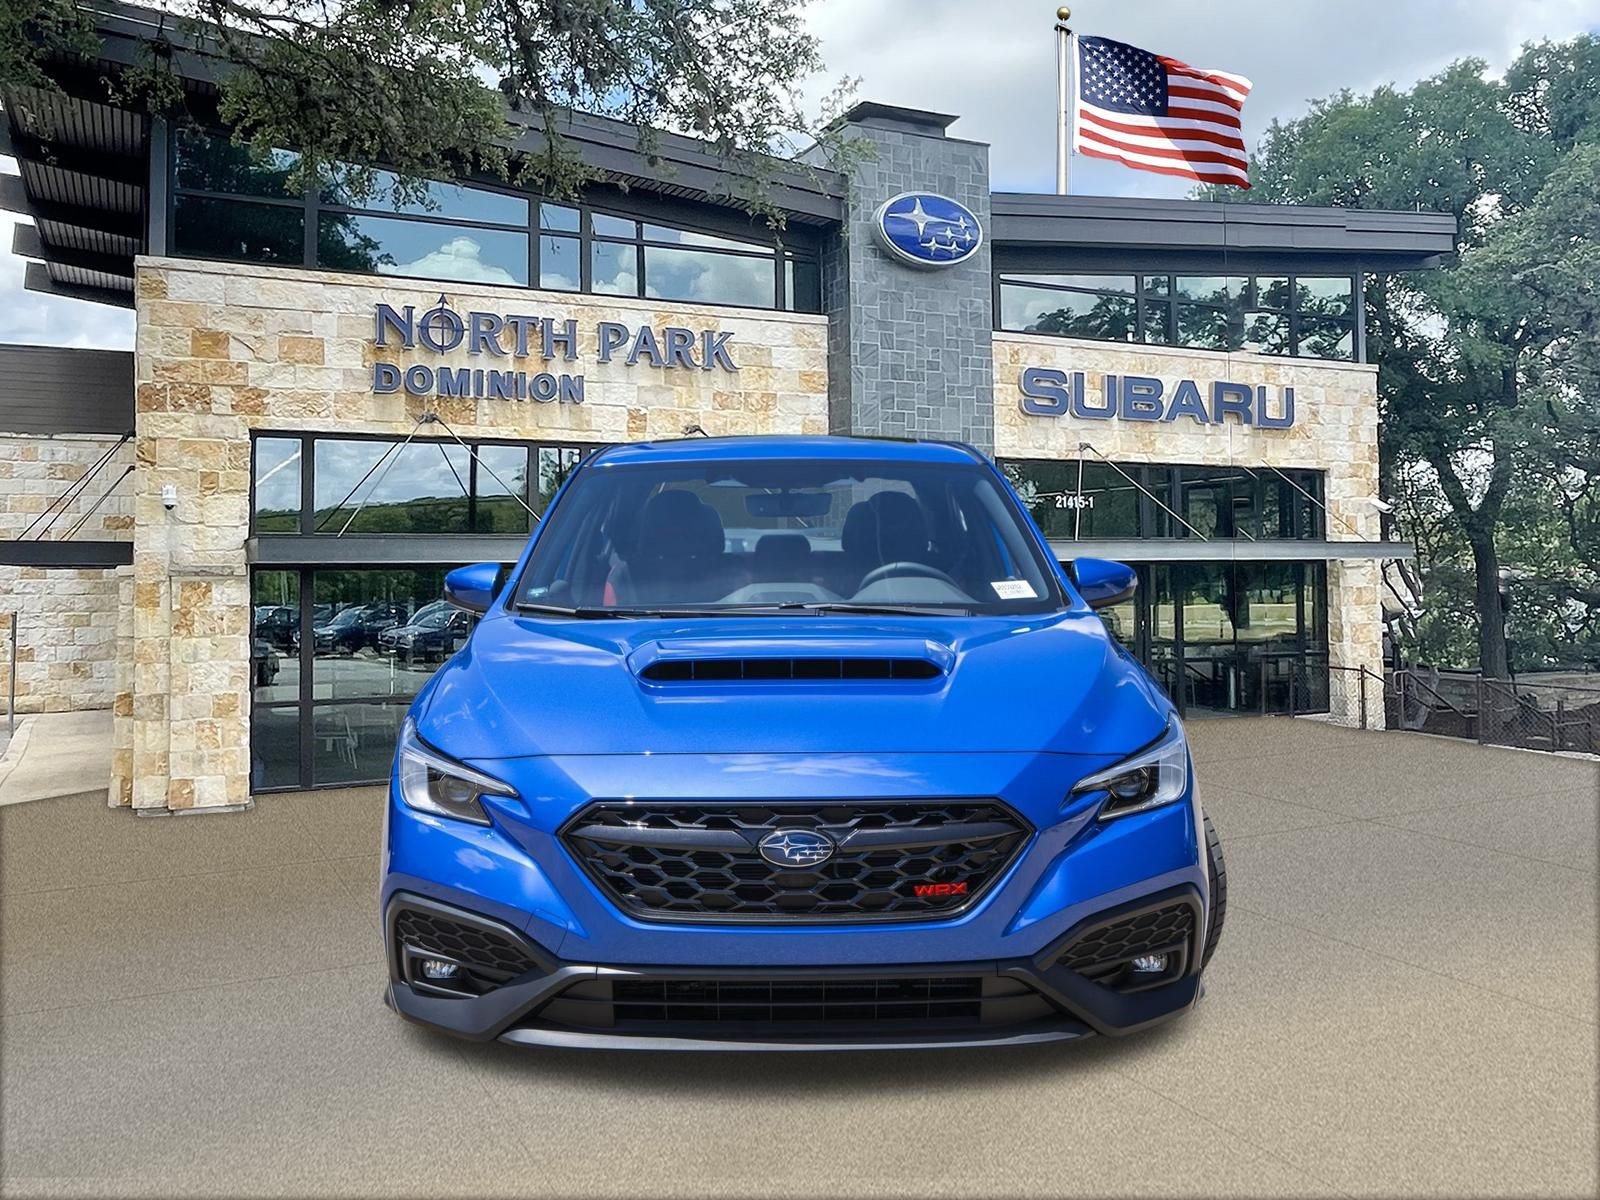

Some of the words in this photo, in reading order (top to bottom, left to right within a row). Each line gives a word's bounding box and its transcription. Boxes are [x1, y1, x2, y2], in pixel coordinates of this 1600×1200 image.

[375, 294, 579, 362] NORTH
[598, 321, 741, 373] PARK
[373, 362, 585, 404] DOMINION
[1018, 367, 1295, 430] SUBARU
[913, 882, 968, 897] WRX
